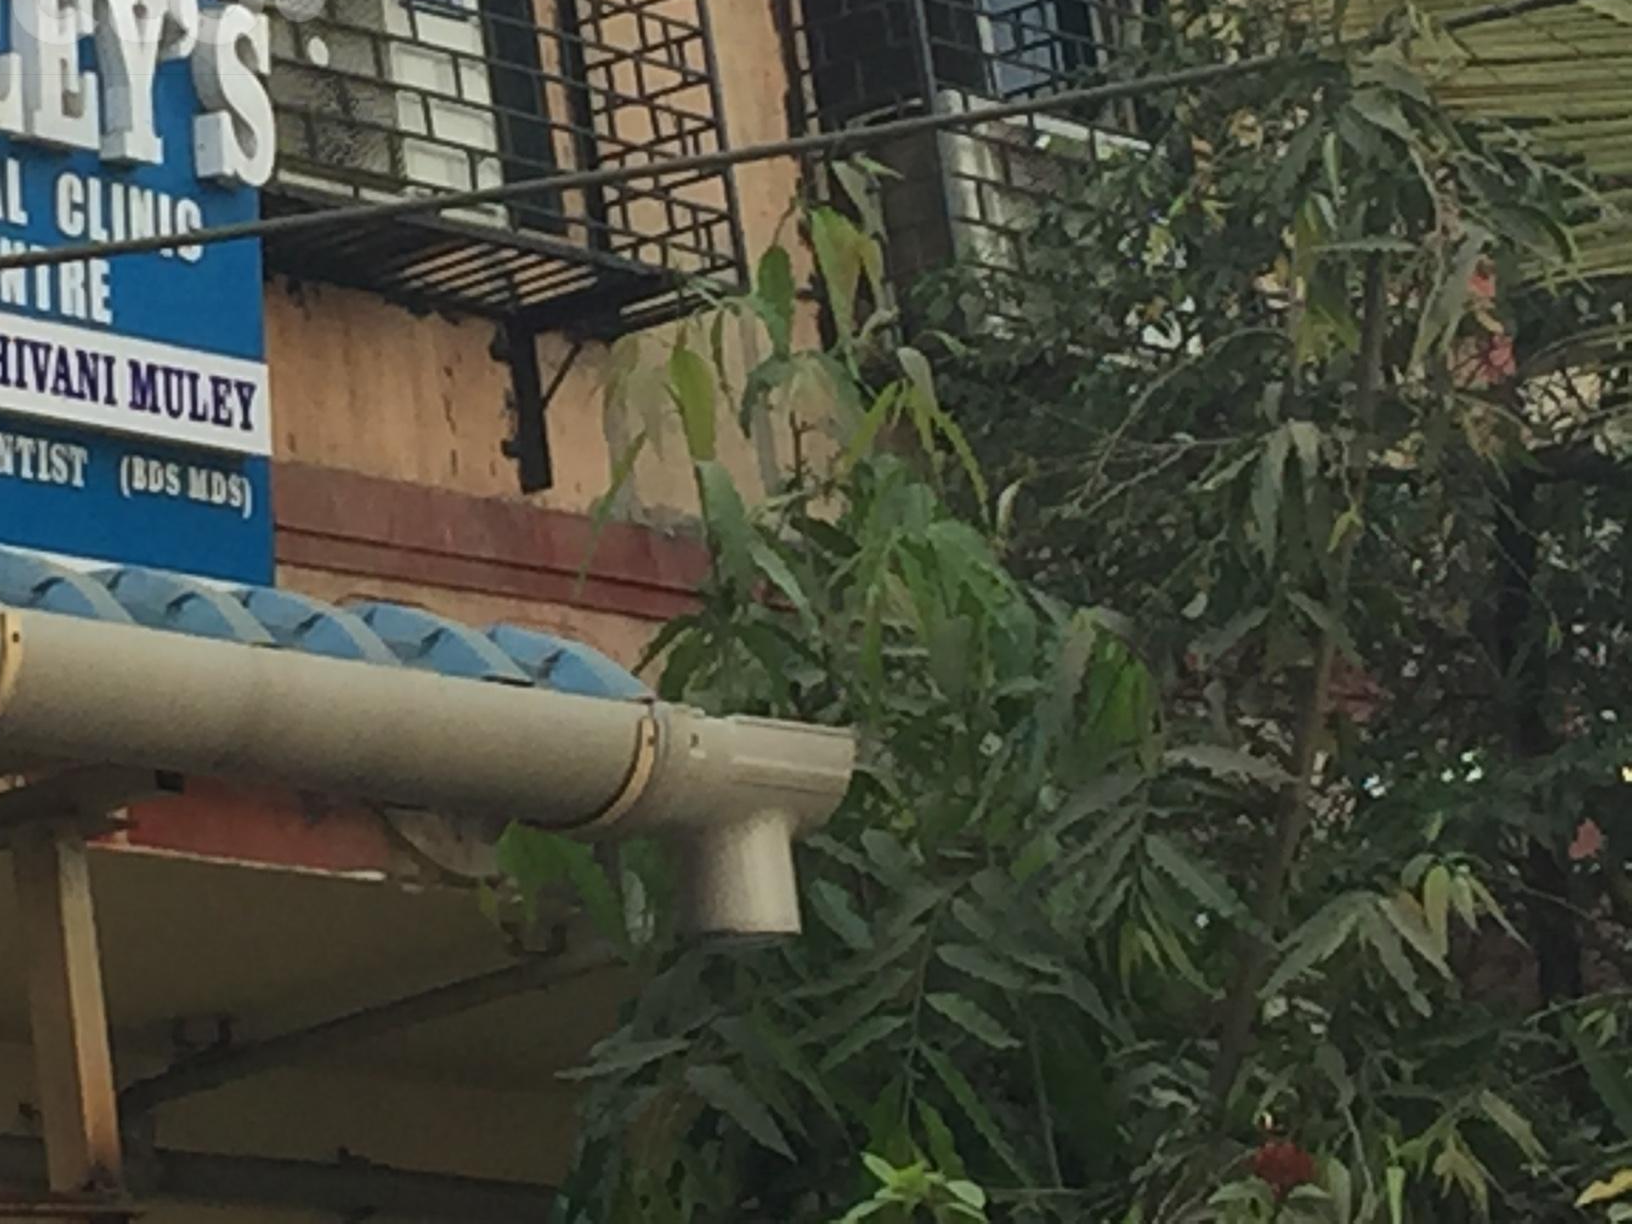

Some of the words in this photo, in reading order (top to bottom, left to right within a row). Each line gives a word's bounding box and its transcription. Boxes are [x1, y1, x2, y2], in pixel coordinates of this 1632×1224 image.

[55, 172, 206, 263] CLINIC
[128, 358, 258, 432] MULEY
[120, 454, 181, 498] (BDS
[187, 466, 253, 518] MDS)
